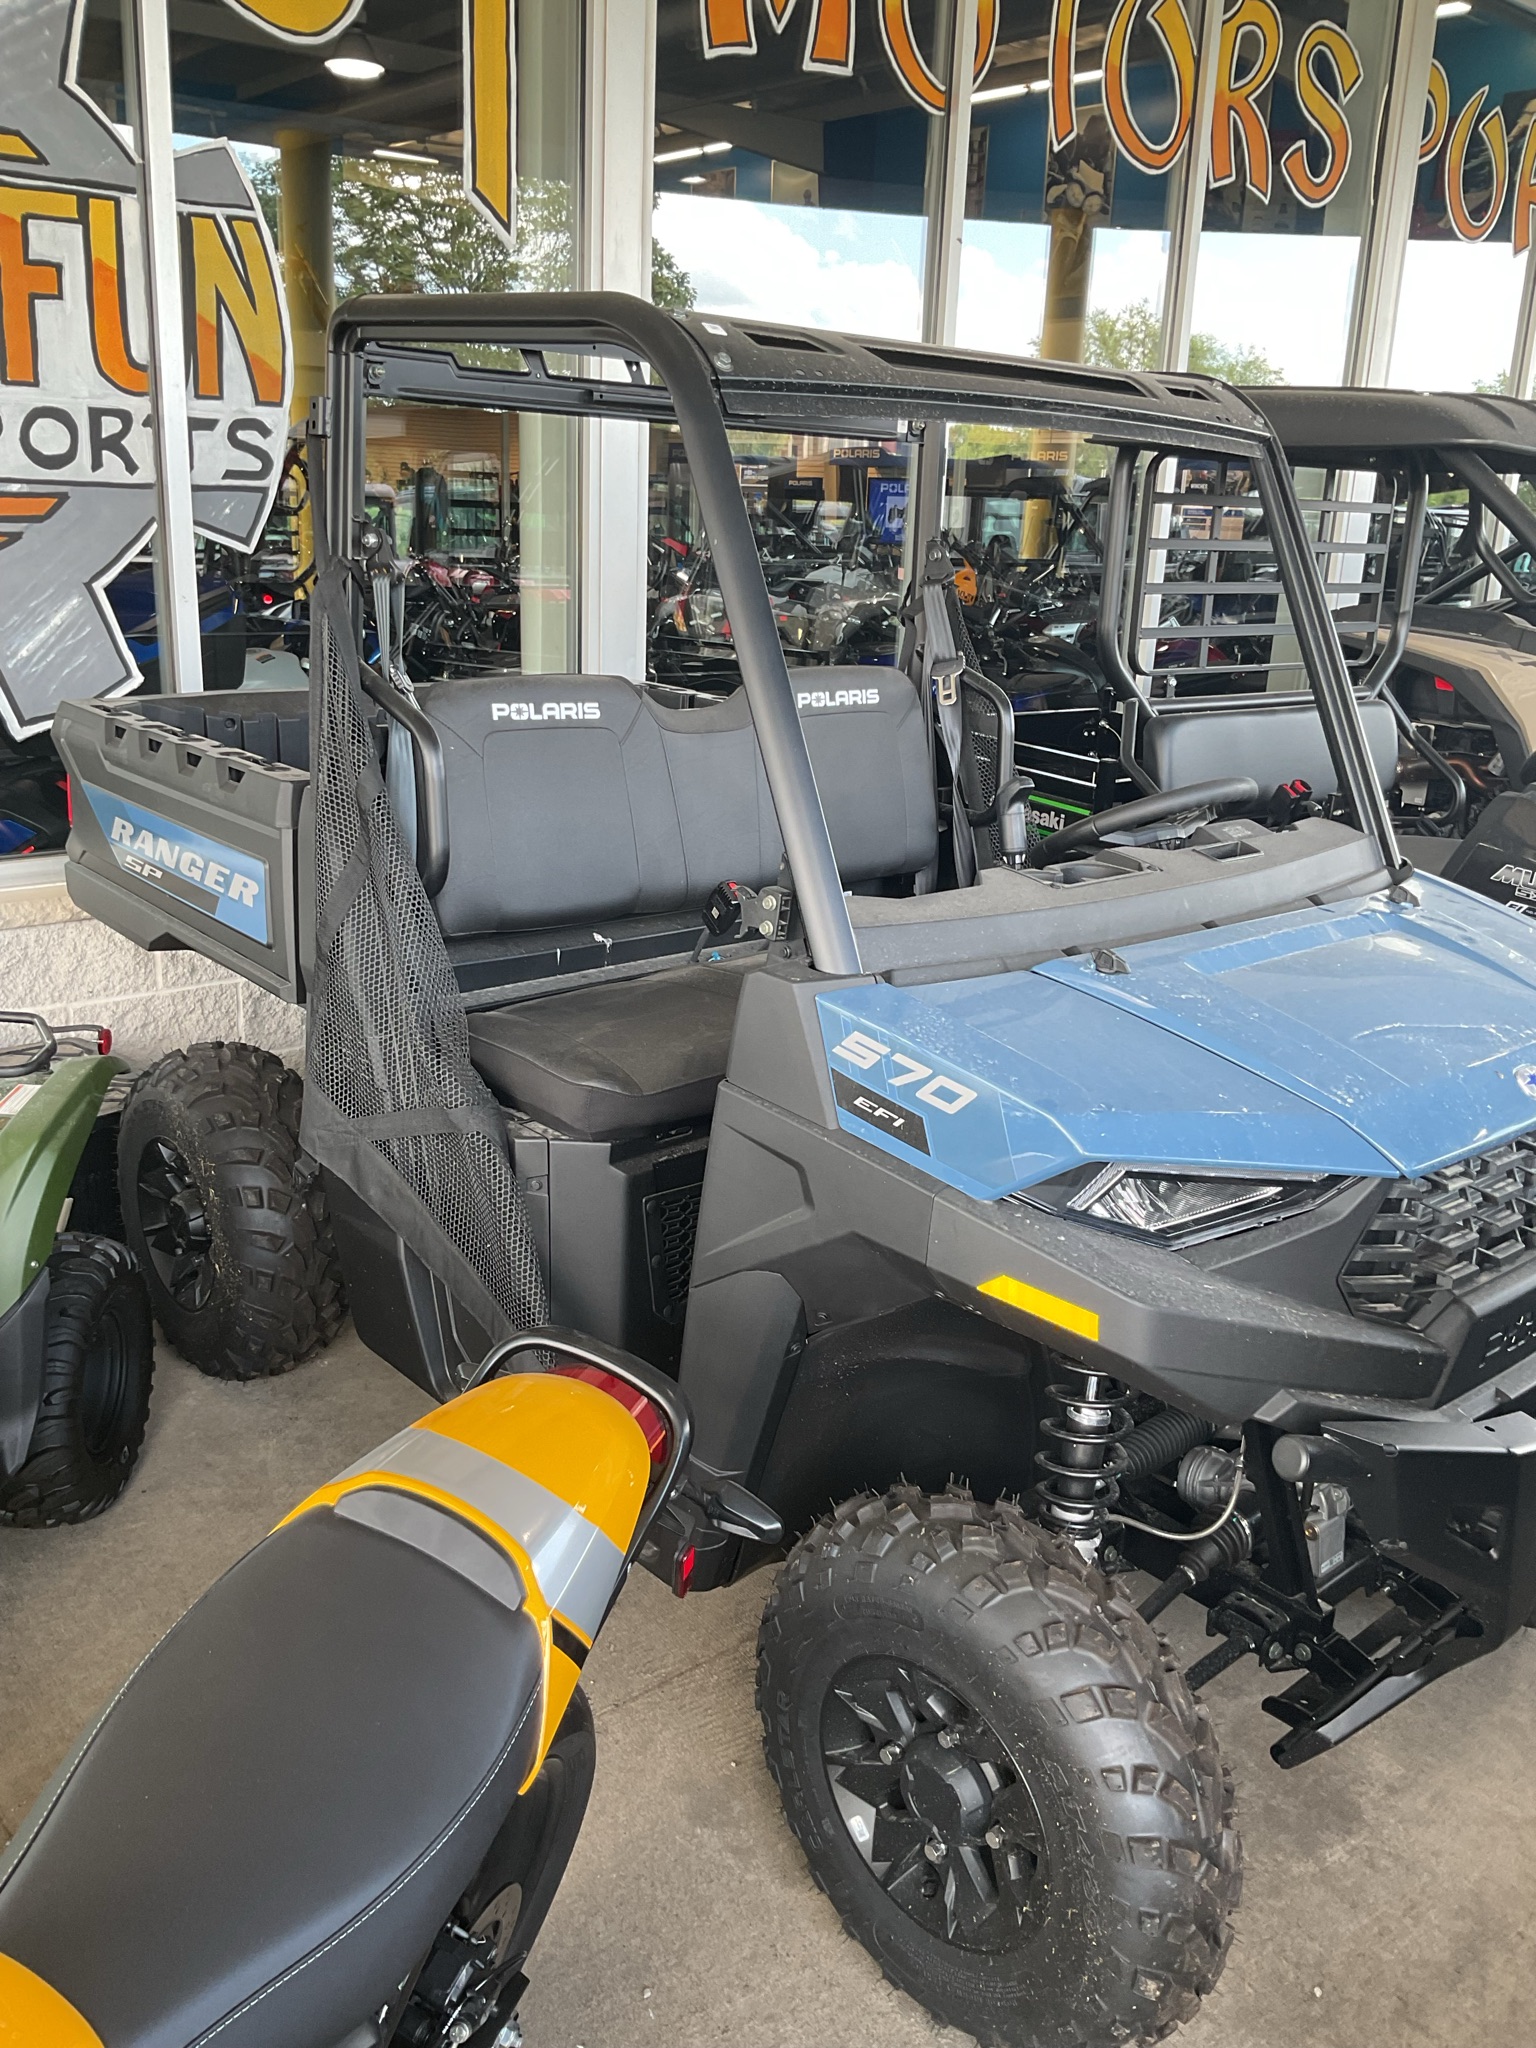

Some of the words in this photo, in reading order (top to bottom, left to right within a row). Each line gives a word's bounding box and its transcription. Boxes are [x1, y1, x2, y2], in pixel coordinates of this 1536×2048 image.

[0, 184, 286, 407] FUN
[0, 405, 273, 481] ORTS
[833, 448, 881, 459] POLARIS
[492, 702, 601, 721] POLARIS
[797, 688, 881, 709] POLARIS
[110, 816, 260, 909] RANGER
[123, 854, 164, 879] SP
[831, 1030, 978, 1115] 570
[852, 1095, 906, 1128] EFI
